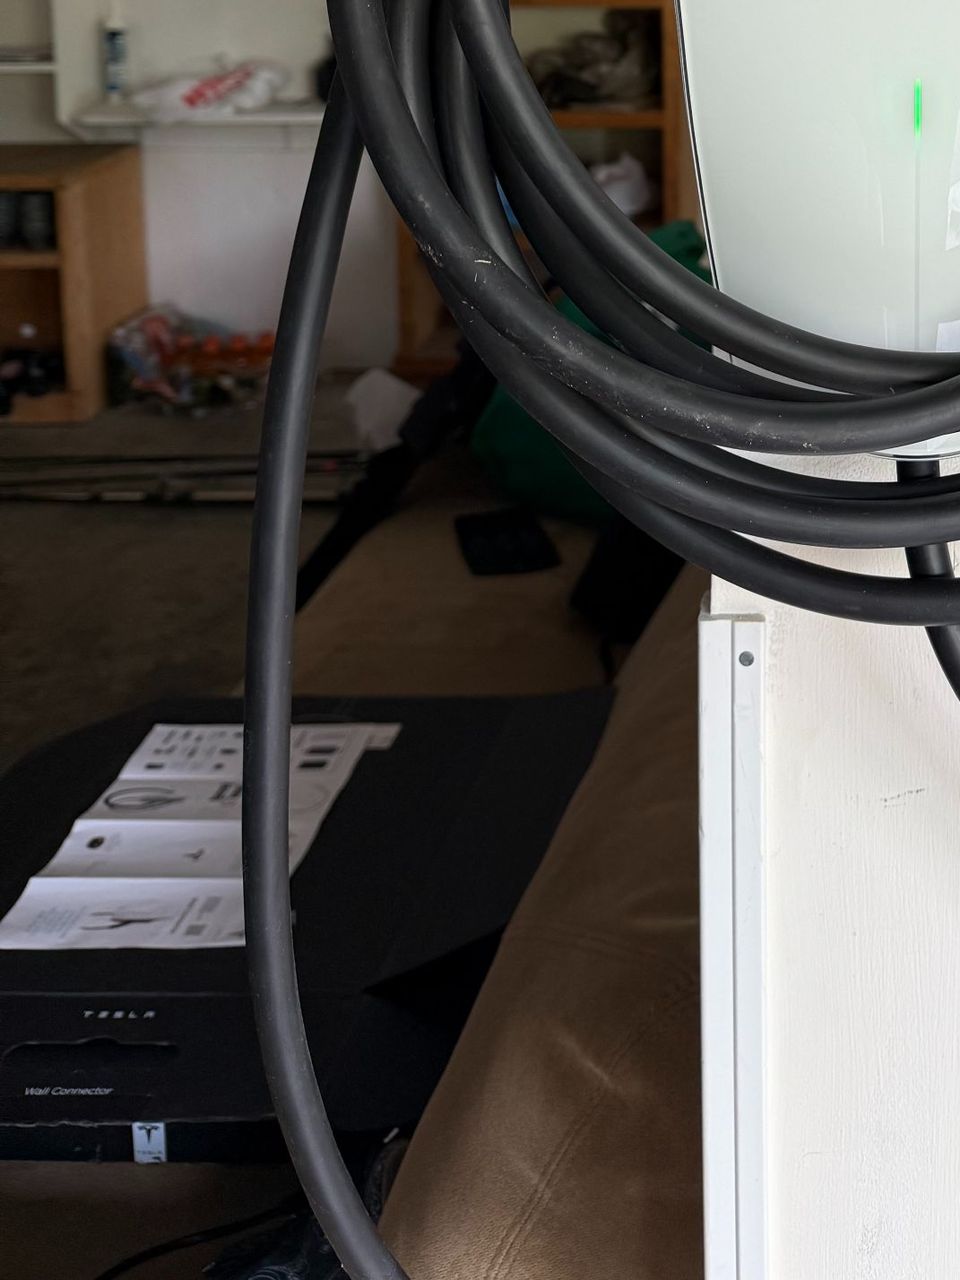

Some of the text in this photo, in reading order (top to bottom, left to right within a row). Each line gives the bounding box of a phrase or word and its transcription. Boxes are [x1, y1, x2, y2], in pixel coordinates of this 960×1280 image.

[83, 1010, 156, 1019] TESLA
[24, 1086, 114, 1096] Wall Connector
